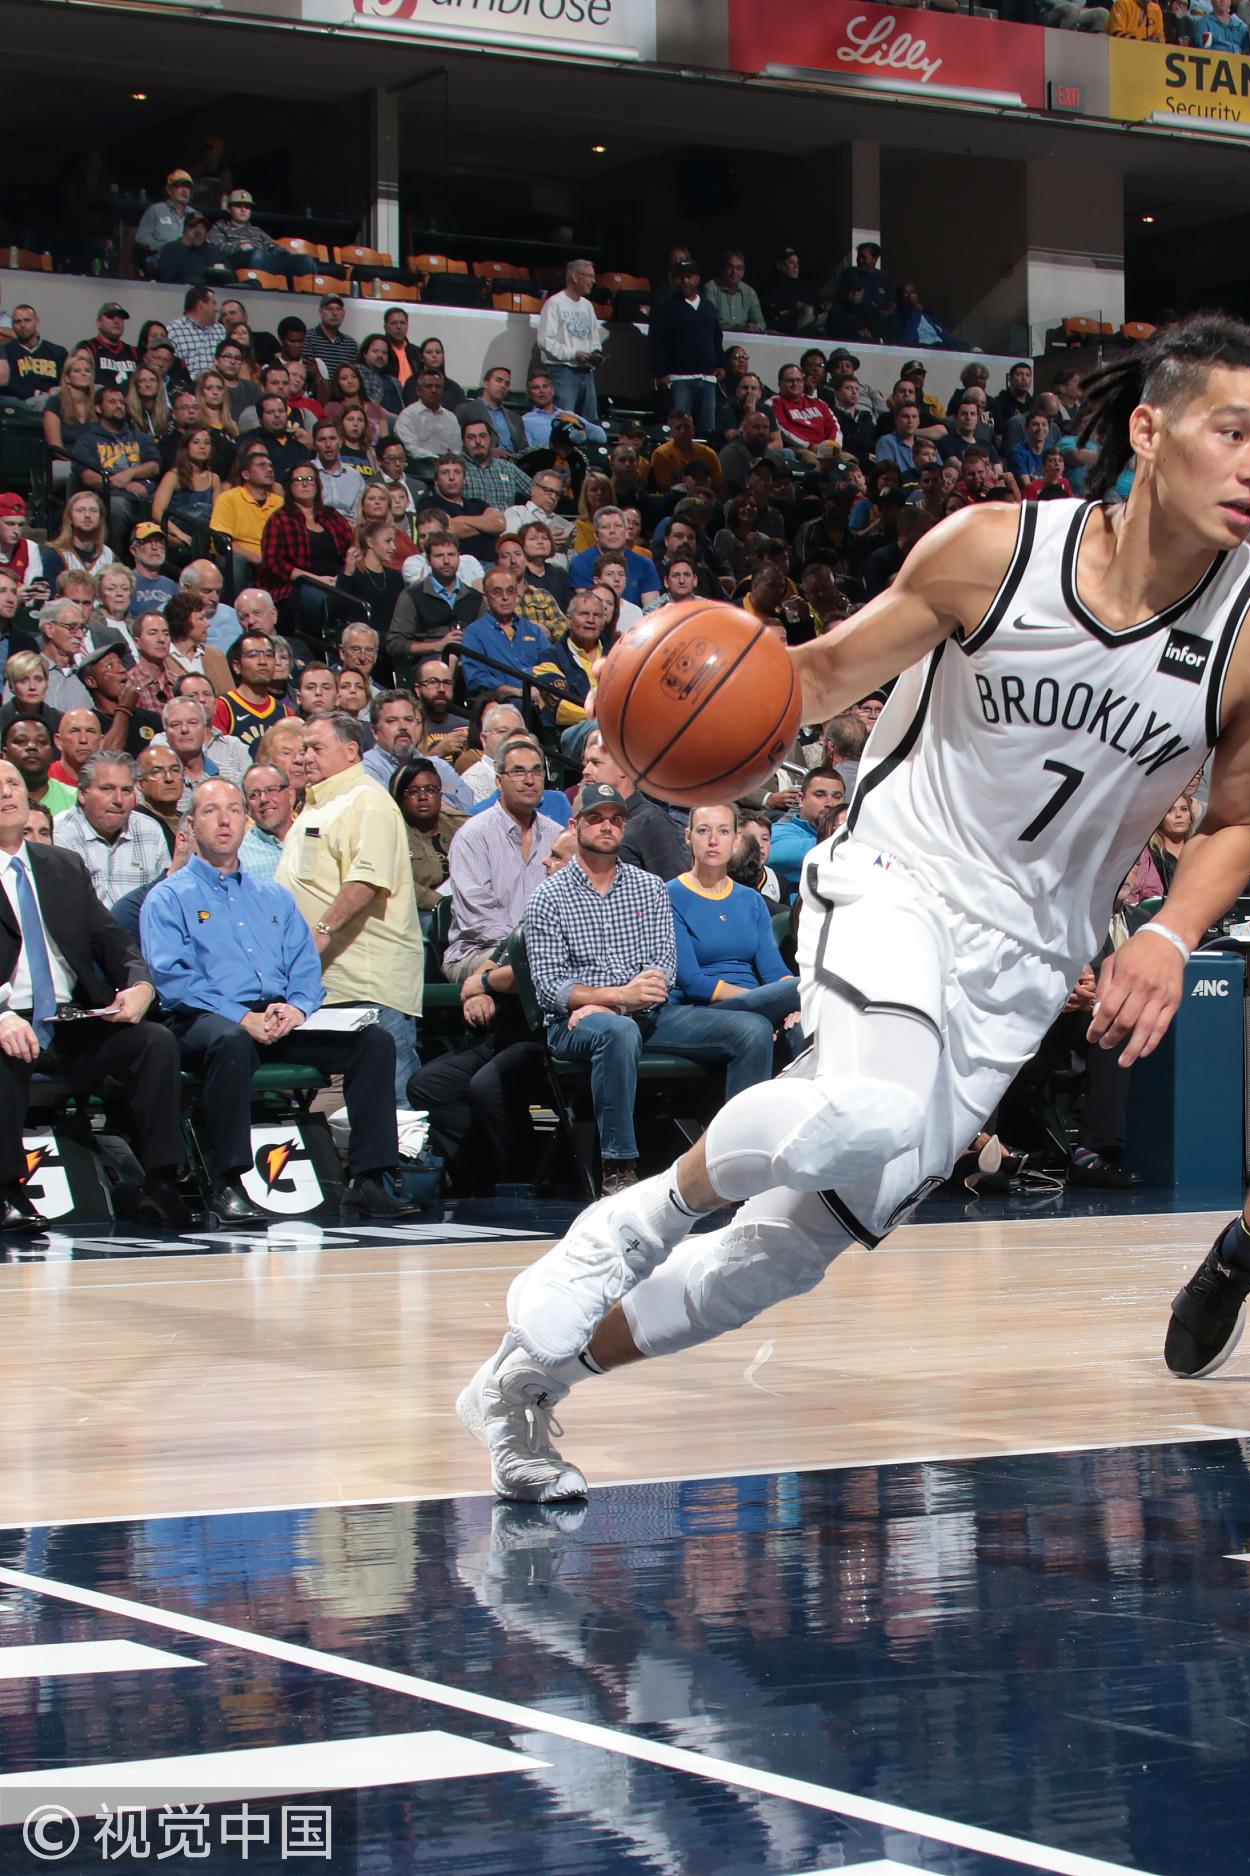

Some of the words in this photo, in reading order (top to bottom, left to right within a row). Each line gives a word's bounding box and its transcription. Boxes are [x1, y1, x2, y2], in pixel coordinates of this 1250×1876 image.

[431, 0, 611, 25] rose
[837, 15, 943, 82] Lilly
[1057, 85, 1081, 107] EXIT
[1165, 642, 1206, 668] infor
[975, 673, 1190, 777] BROOKLYN
[1017, 759, 1085, 842] 7
[1191, 979, 1229, 997] ANC
[240, 1120, 324, 1214] G
